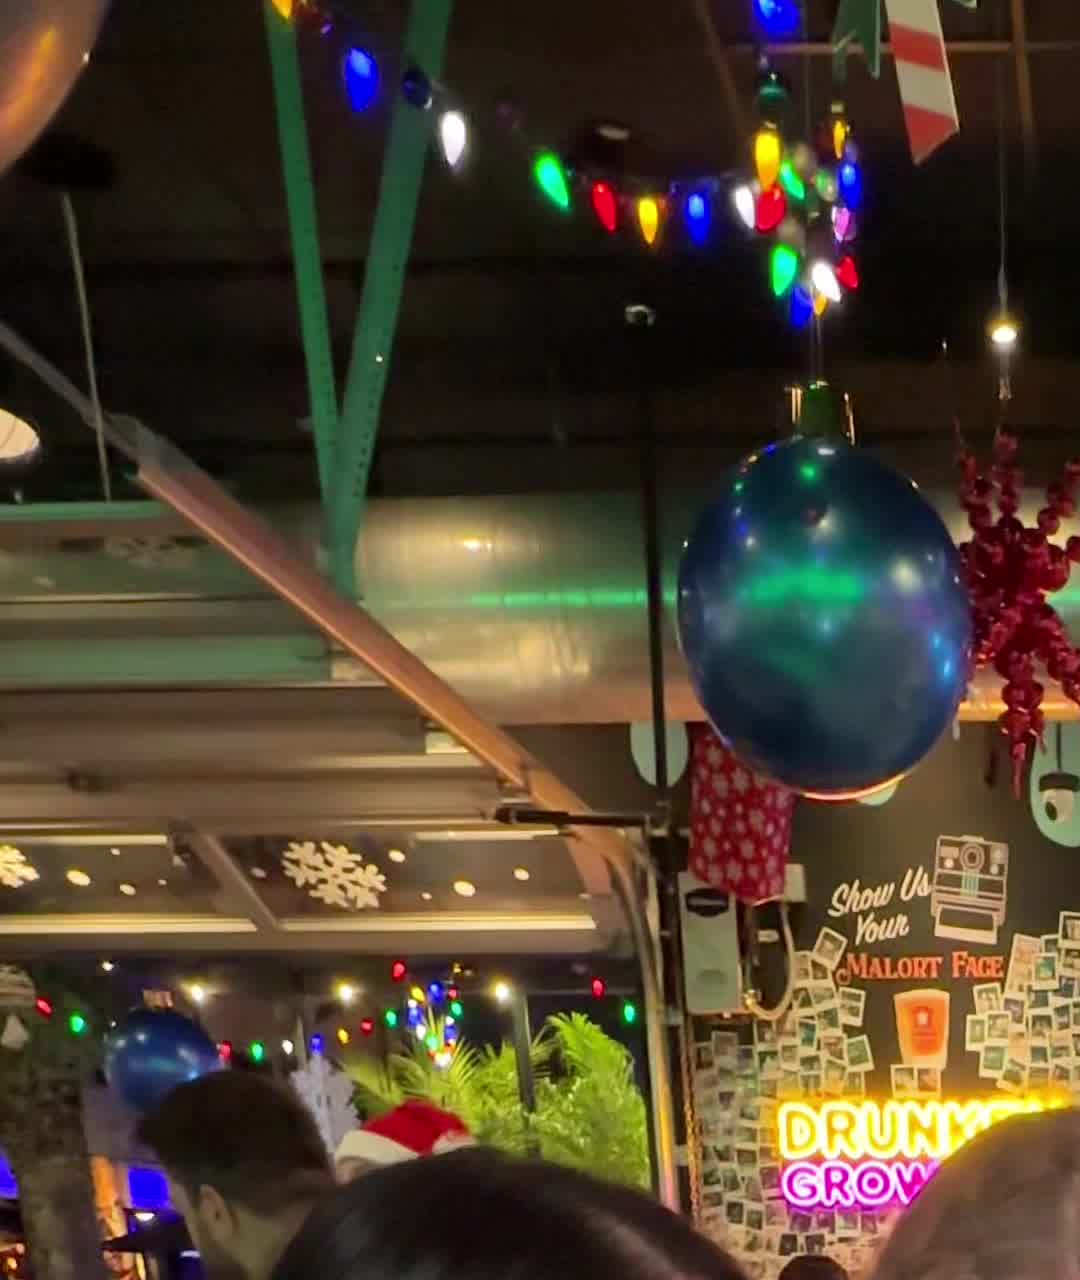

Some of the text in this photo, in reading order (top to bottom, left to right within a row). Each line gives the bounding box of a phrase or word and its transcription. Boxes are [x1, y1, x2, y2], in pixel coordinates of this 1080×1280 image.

[828, 866, 932, 917] Show Us
[855, 912, 910, 946] Your
[836, 951, 1004, 985] MALORT FACE
